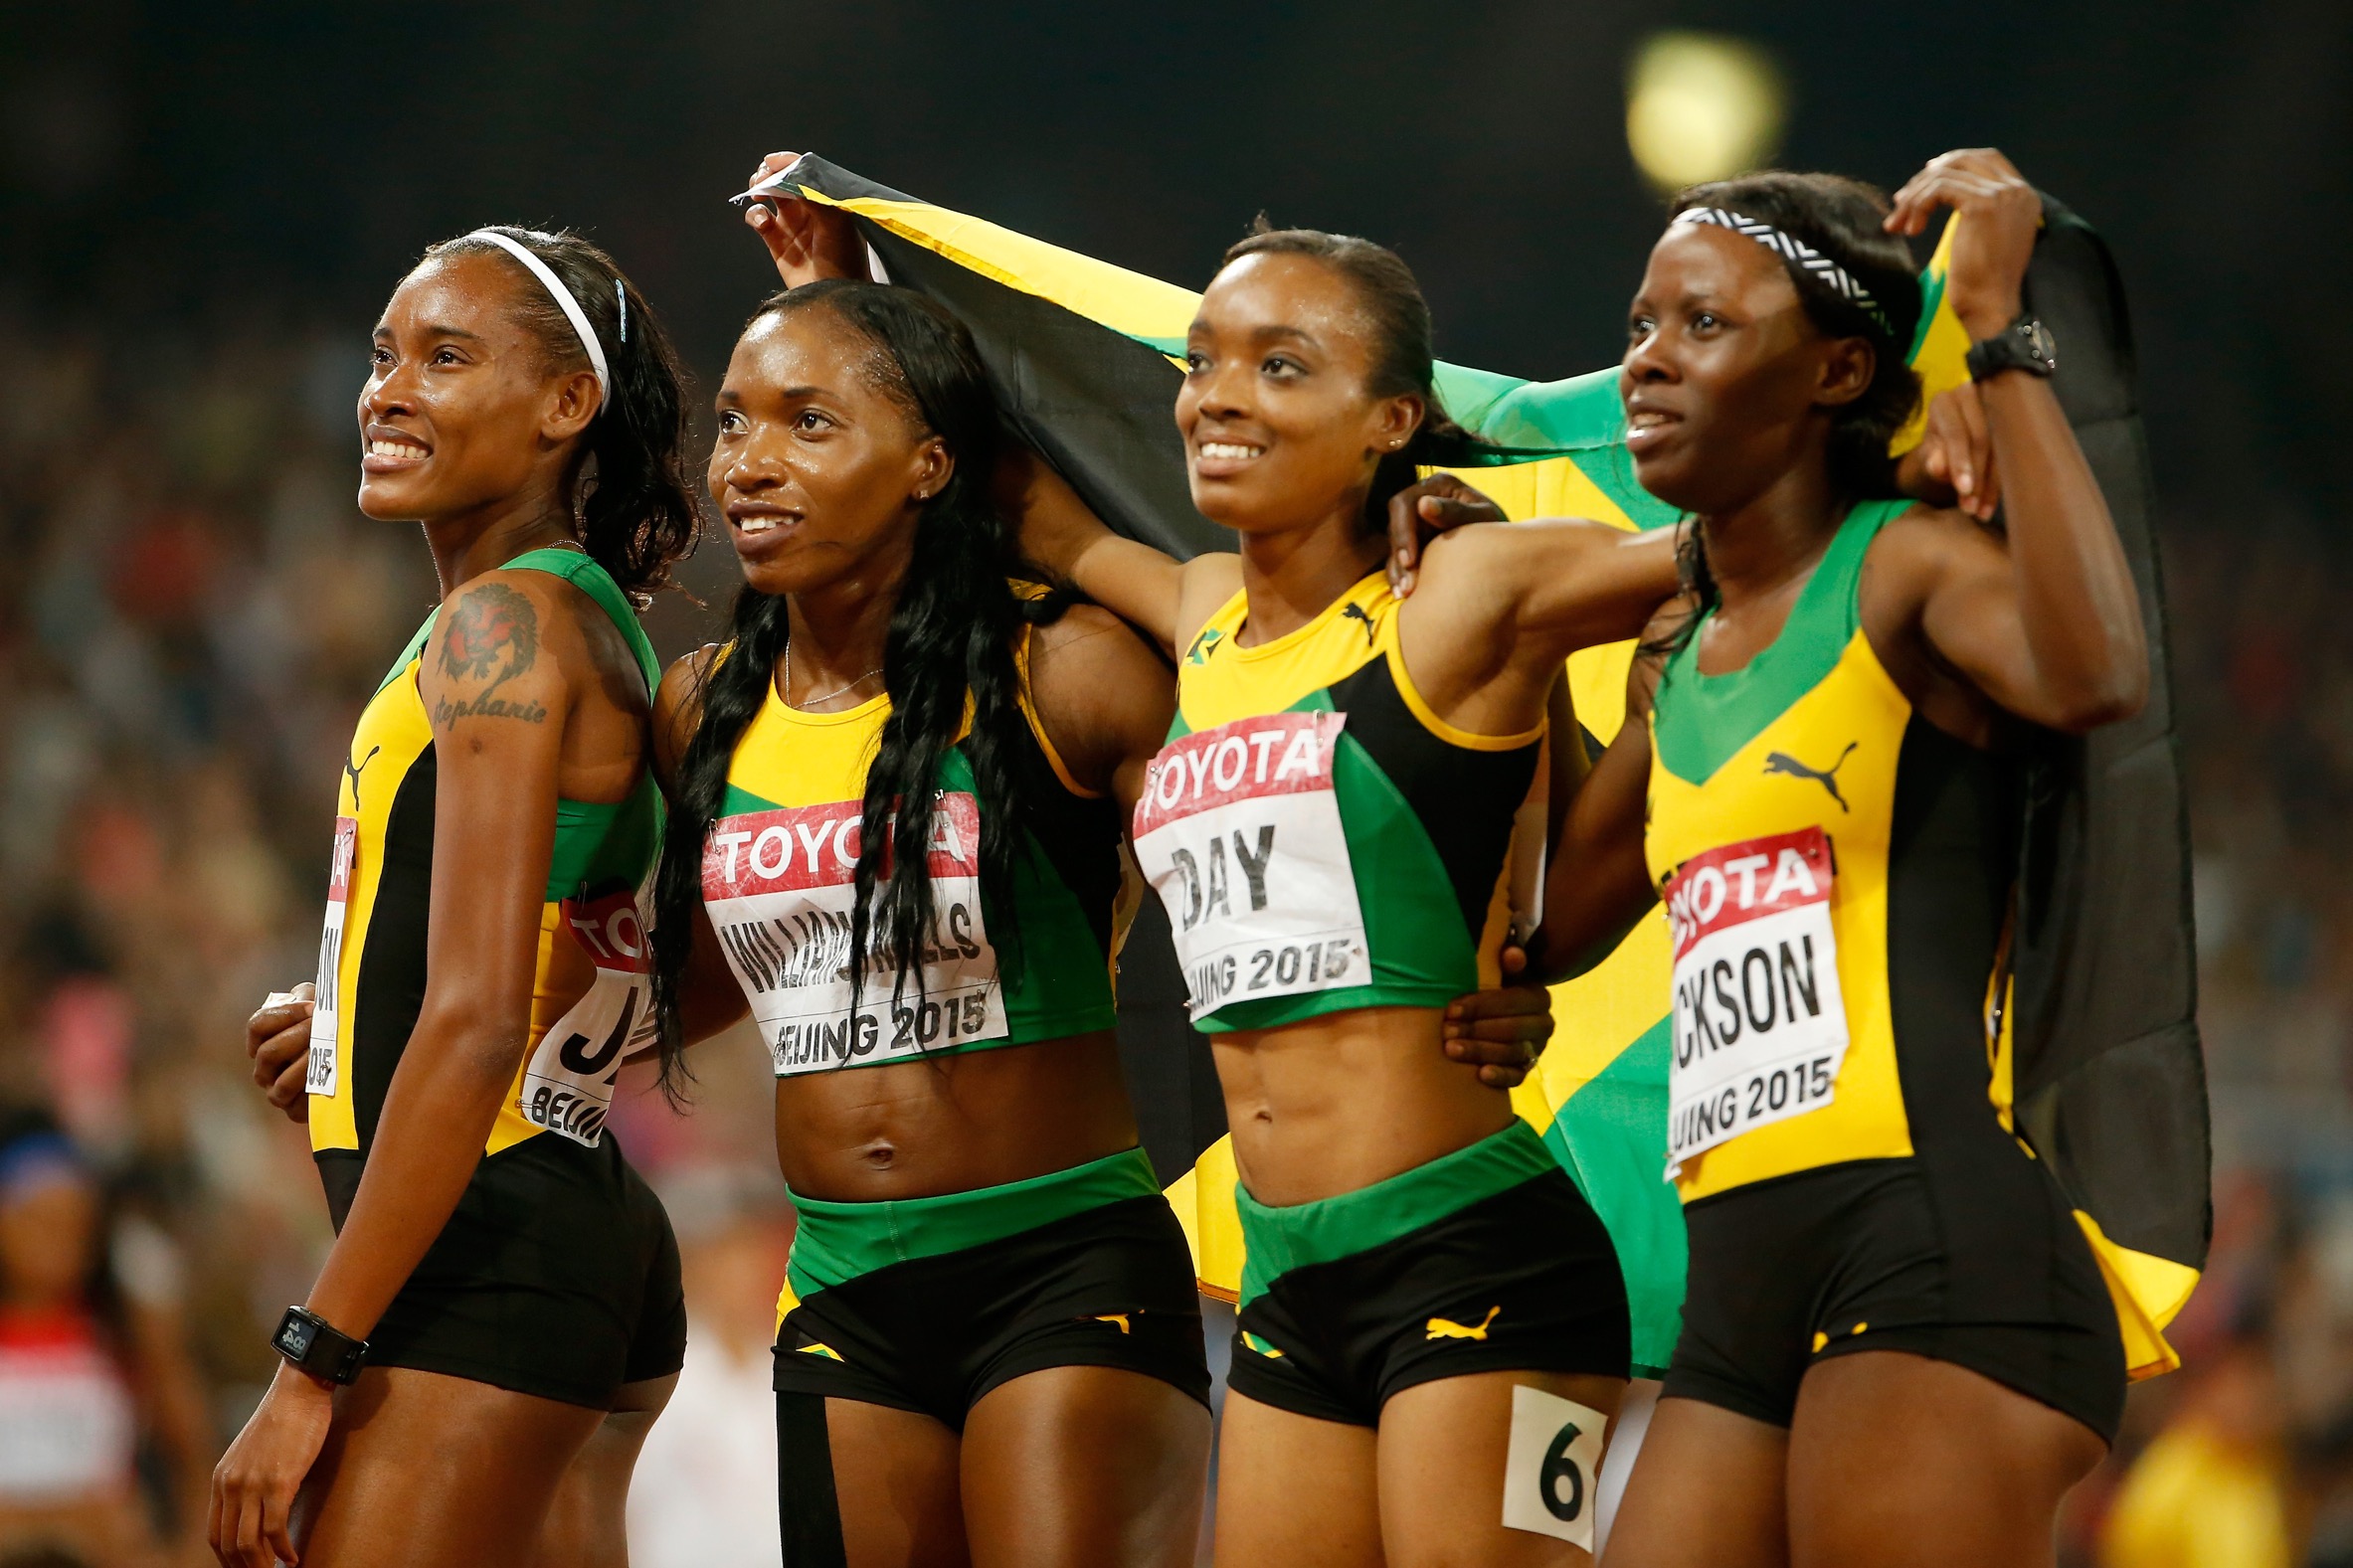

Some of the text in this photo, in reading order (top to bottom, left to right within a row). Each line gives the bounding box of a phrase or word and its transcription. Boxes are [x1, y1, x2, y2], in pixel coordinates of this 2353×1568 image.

[716, 809, 967, 883] TOYOA
[1171, 824, 1277, 933] DAY
[1247, 939, 1351, 991] 2015
[890, 994, 986, 1050] 2015
[1747, 1056, 1833, 1121] 2015
[1539, 1422, 1583, 1523] 6
